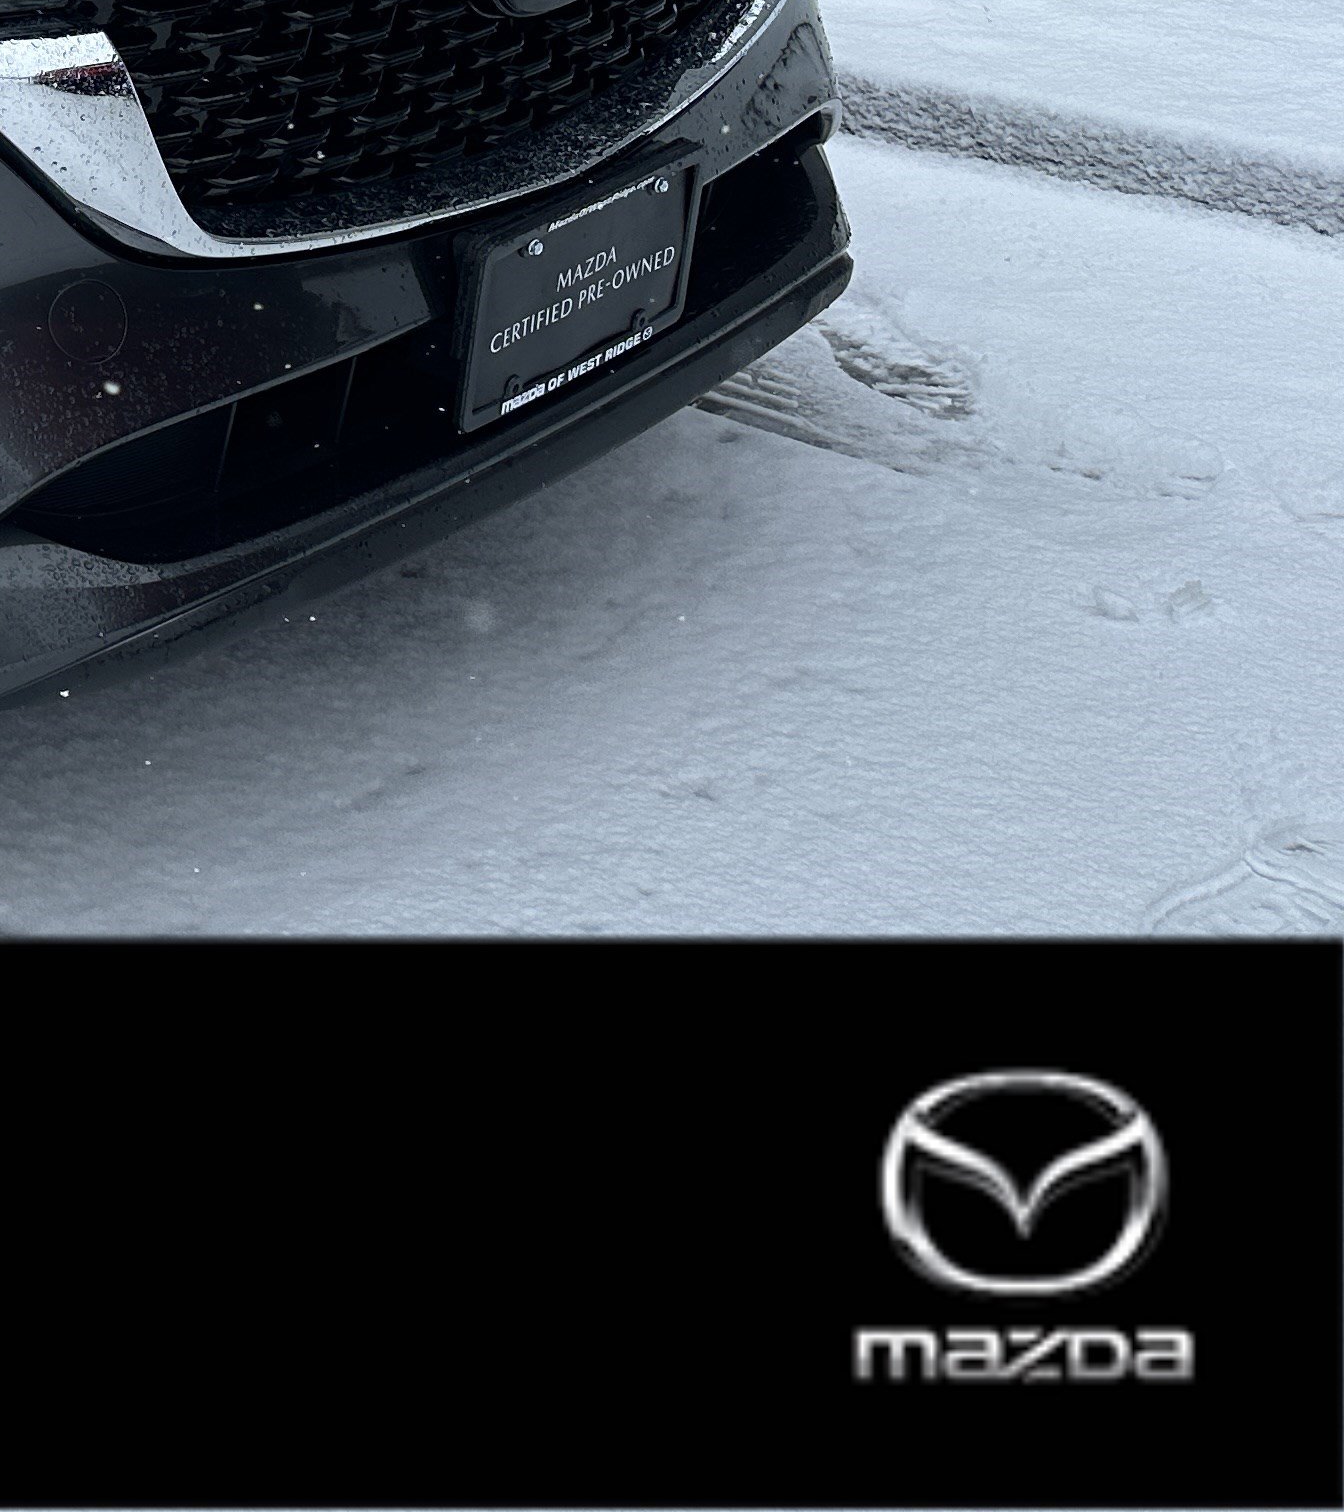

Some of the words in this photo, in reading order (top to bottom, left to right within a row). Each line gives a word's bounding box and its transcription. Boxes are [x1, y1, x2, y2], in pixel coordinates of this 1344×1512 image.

[556, 245, 617, 293] MAZDA
[489, 297, 573, 354] CERTIFIED
[577, 246, 676, 310] PRE-OWNED
[547, 372, 566, 392] OF
[567, 352, 604, 382] WEST
[604, 331, 642, 363] RIDGE
